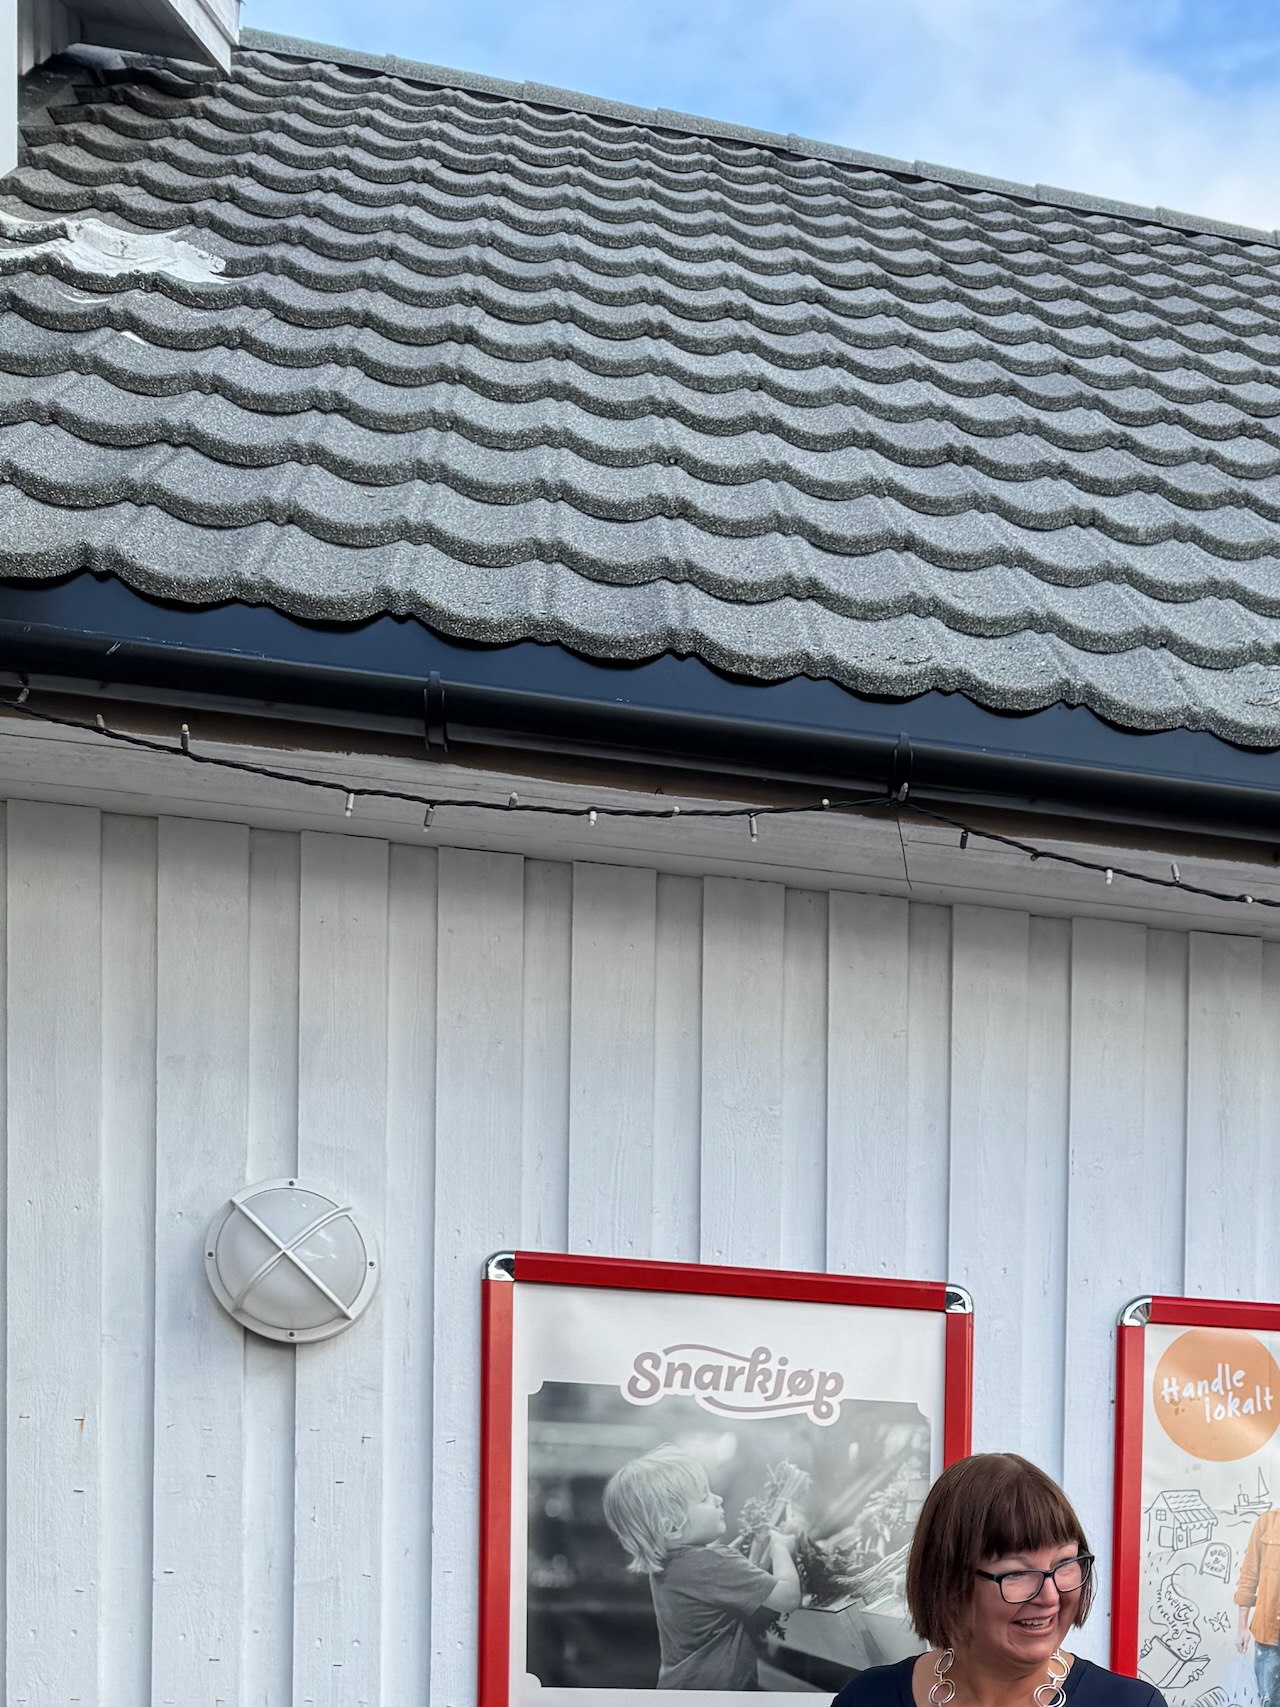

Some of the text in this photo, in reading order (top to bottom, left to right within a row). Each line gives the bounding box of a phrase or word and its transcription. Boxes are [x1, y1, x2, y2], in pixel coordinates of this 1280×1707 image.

[627, 1343, 844, 1420] Snarkjøp
[1161, 1362, 1246, 1403] Handle
[1204, 1385, 1274, 1424] lokalt
